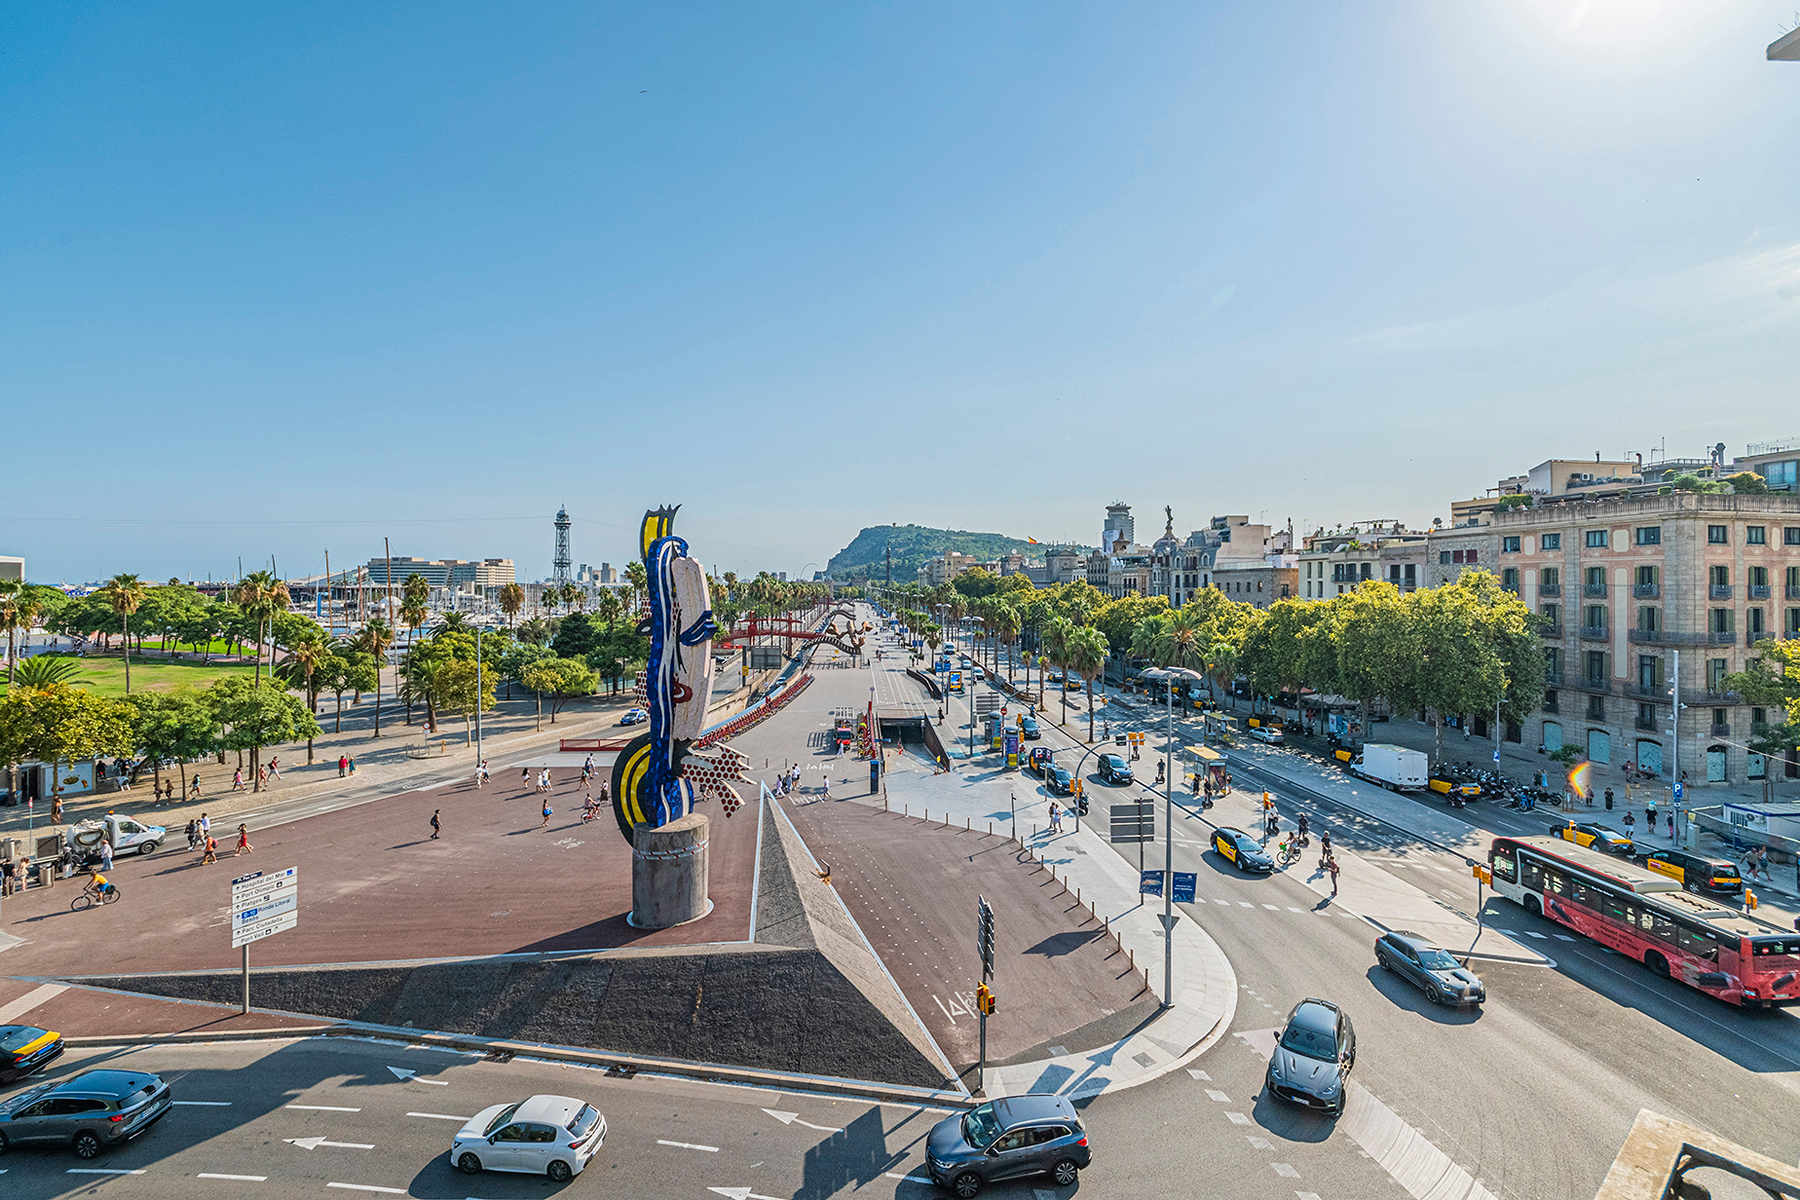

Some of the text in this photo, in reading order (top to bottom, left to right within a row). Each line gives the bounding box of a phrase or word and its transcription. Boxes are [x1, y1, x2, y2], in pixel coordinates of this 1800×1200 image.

[241, 877, 265, 889] Hospital
[241, 890, 254, 898] Port
[241, 898, 262, 908] Platges
[258, 903, 274, 912] Ronda
[275, 898, 291, 907] Litoral
[241, 917, 282, 933] Parc Ciutadella
[240, 930, 265, 943] Port Vell
